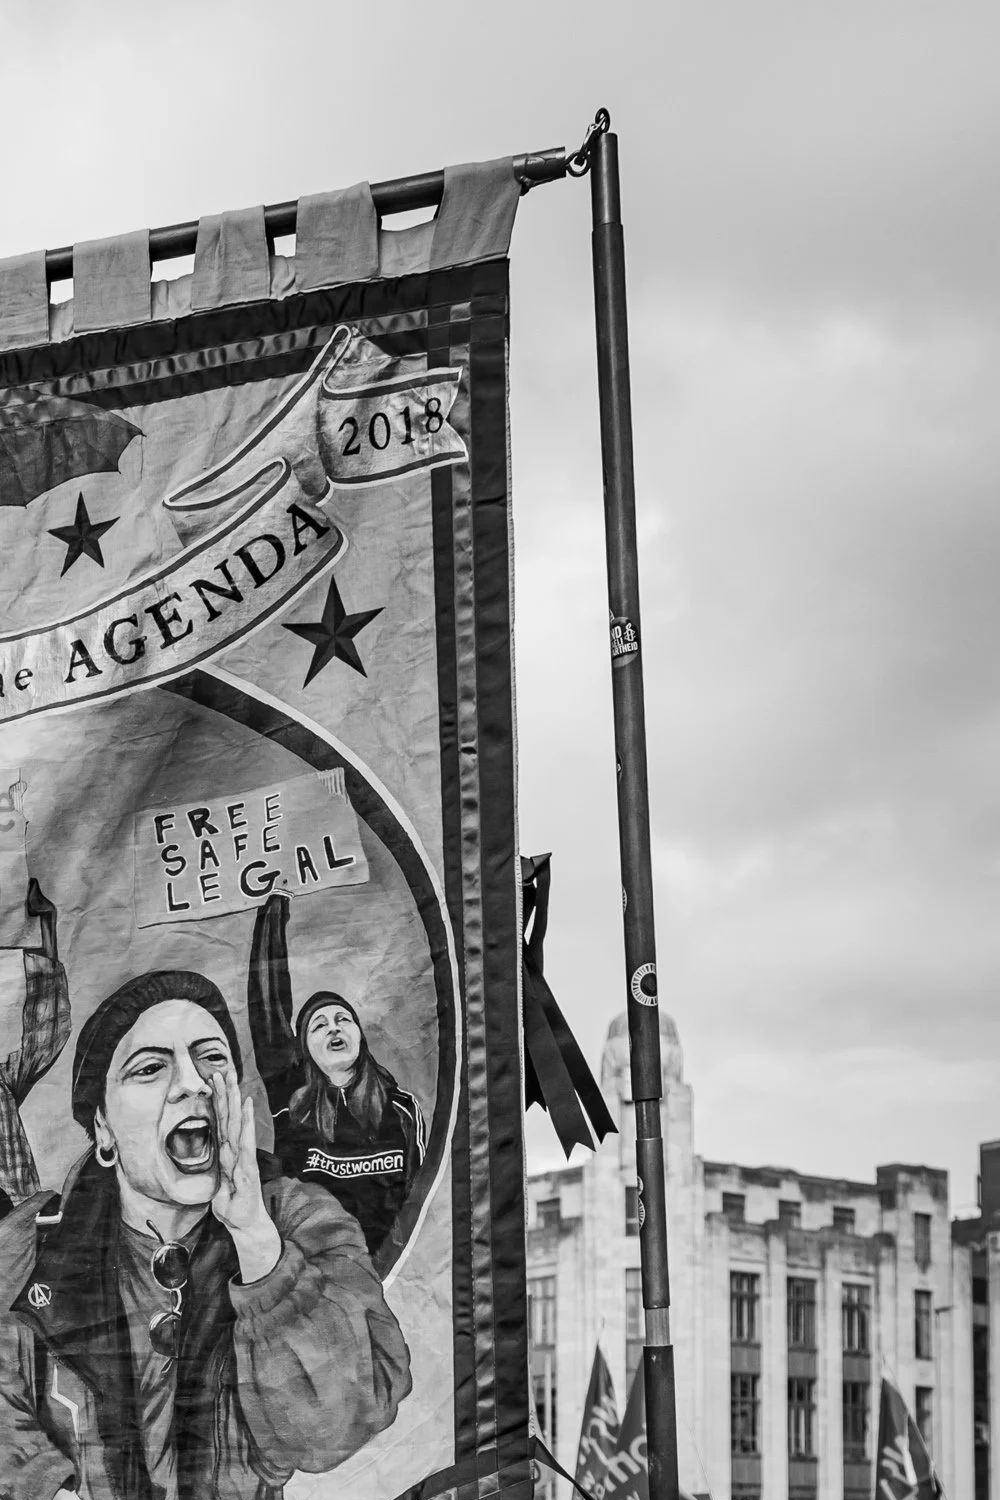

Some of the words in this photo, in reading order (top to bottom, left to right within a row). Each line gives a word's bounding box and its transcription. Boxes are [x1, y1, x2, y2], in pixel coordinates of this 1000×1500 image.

[338, 397, 444, 457] 2018
[63, 503, 331, 684] AGENDA
[154, 794, 284, 844] FREE
[160, 825, 282, 877] SAFE
[165, 836, 355, 913] LEGAL
[306, 1153, 404, 1175] #trustwomen
